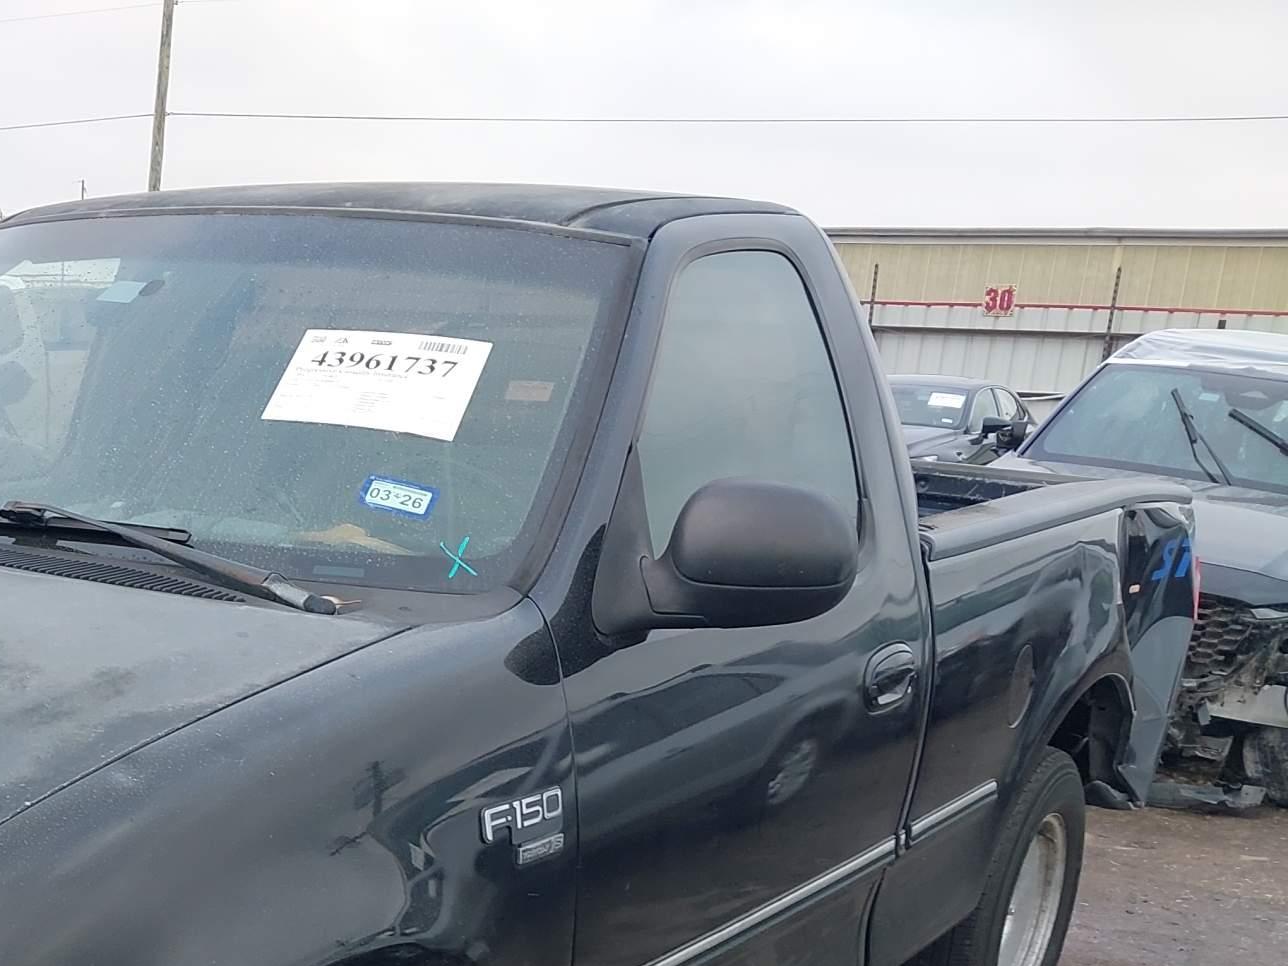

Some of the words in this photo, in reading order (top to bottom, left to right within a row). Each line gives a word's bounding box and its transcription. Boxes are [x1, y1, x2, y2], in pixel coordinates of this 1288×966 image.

[984, 288, 1013, 312] 30
[311, 350, 459, 378] 43961737
[484, 788, 562, 841] F-150
